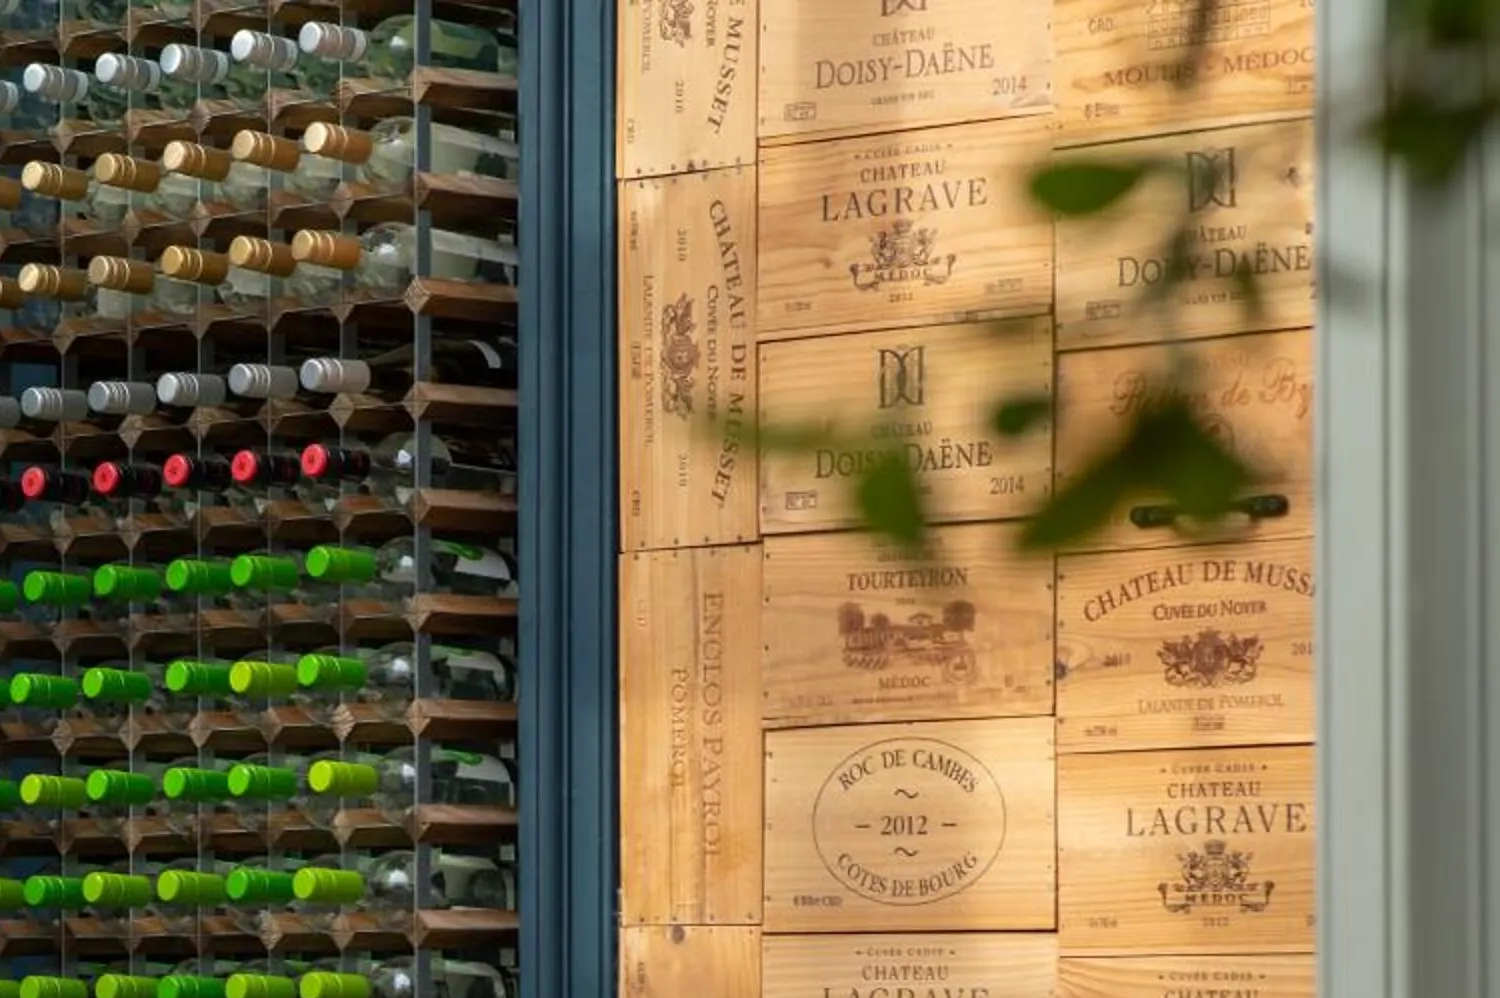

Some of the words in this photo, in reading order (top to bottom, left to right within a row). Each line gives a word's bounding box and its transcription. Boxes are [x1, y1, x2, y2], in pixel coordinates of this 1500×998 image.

[641, 0, 652, 73] OMEROL
[705, 0, 718, 47] OYER
[708, 16, 744, 134] MUSSET
[816, 43, 994, 89] DOISY-DAËNE
[992, 75, 1027, 96] 2014
[861, 160, 945, 183] CHATEAU
[822, 178, 988, 222] LAGRAVE
[1184, 224, 1247, 244] HÂTEAU
[1118, 242, 1311, 287] DOY-DAËNE
[731, 344, 747, 380] DE
[711, 392, 744, 508] MUSSET
[815, 439, 993, 479] DOISDAËNE
[990, 476, 1025, 496] 2014
[1083, 563, 1196, 622] CHATEAU
[1203, 560, 1236, 582] DE
[1244, 560, 1315, 597] MUSS
[702, 591, 725, 726] ENCLOS
[1291, 642, 1314, 656] 201
[838, 757, 877, 791] ROC
[883, 750, 906, 769] DE
[913, 749, 979, 794] CAMBES
[1167, 781, 1261, 799] CHATEAU
[880, 815, 928, 835] 2012
[1126, 803, 1307, 837] LAGRAVE
[892, 878, 913, 896] DE
[919, 851, 978, 896] BOURG
[862, 965, 949, 981] CHATEAU
